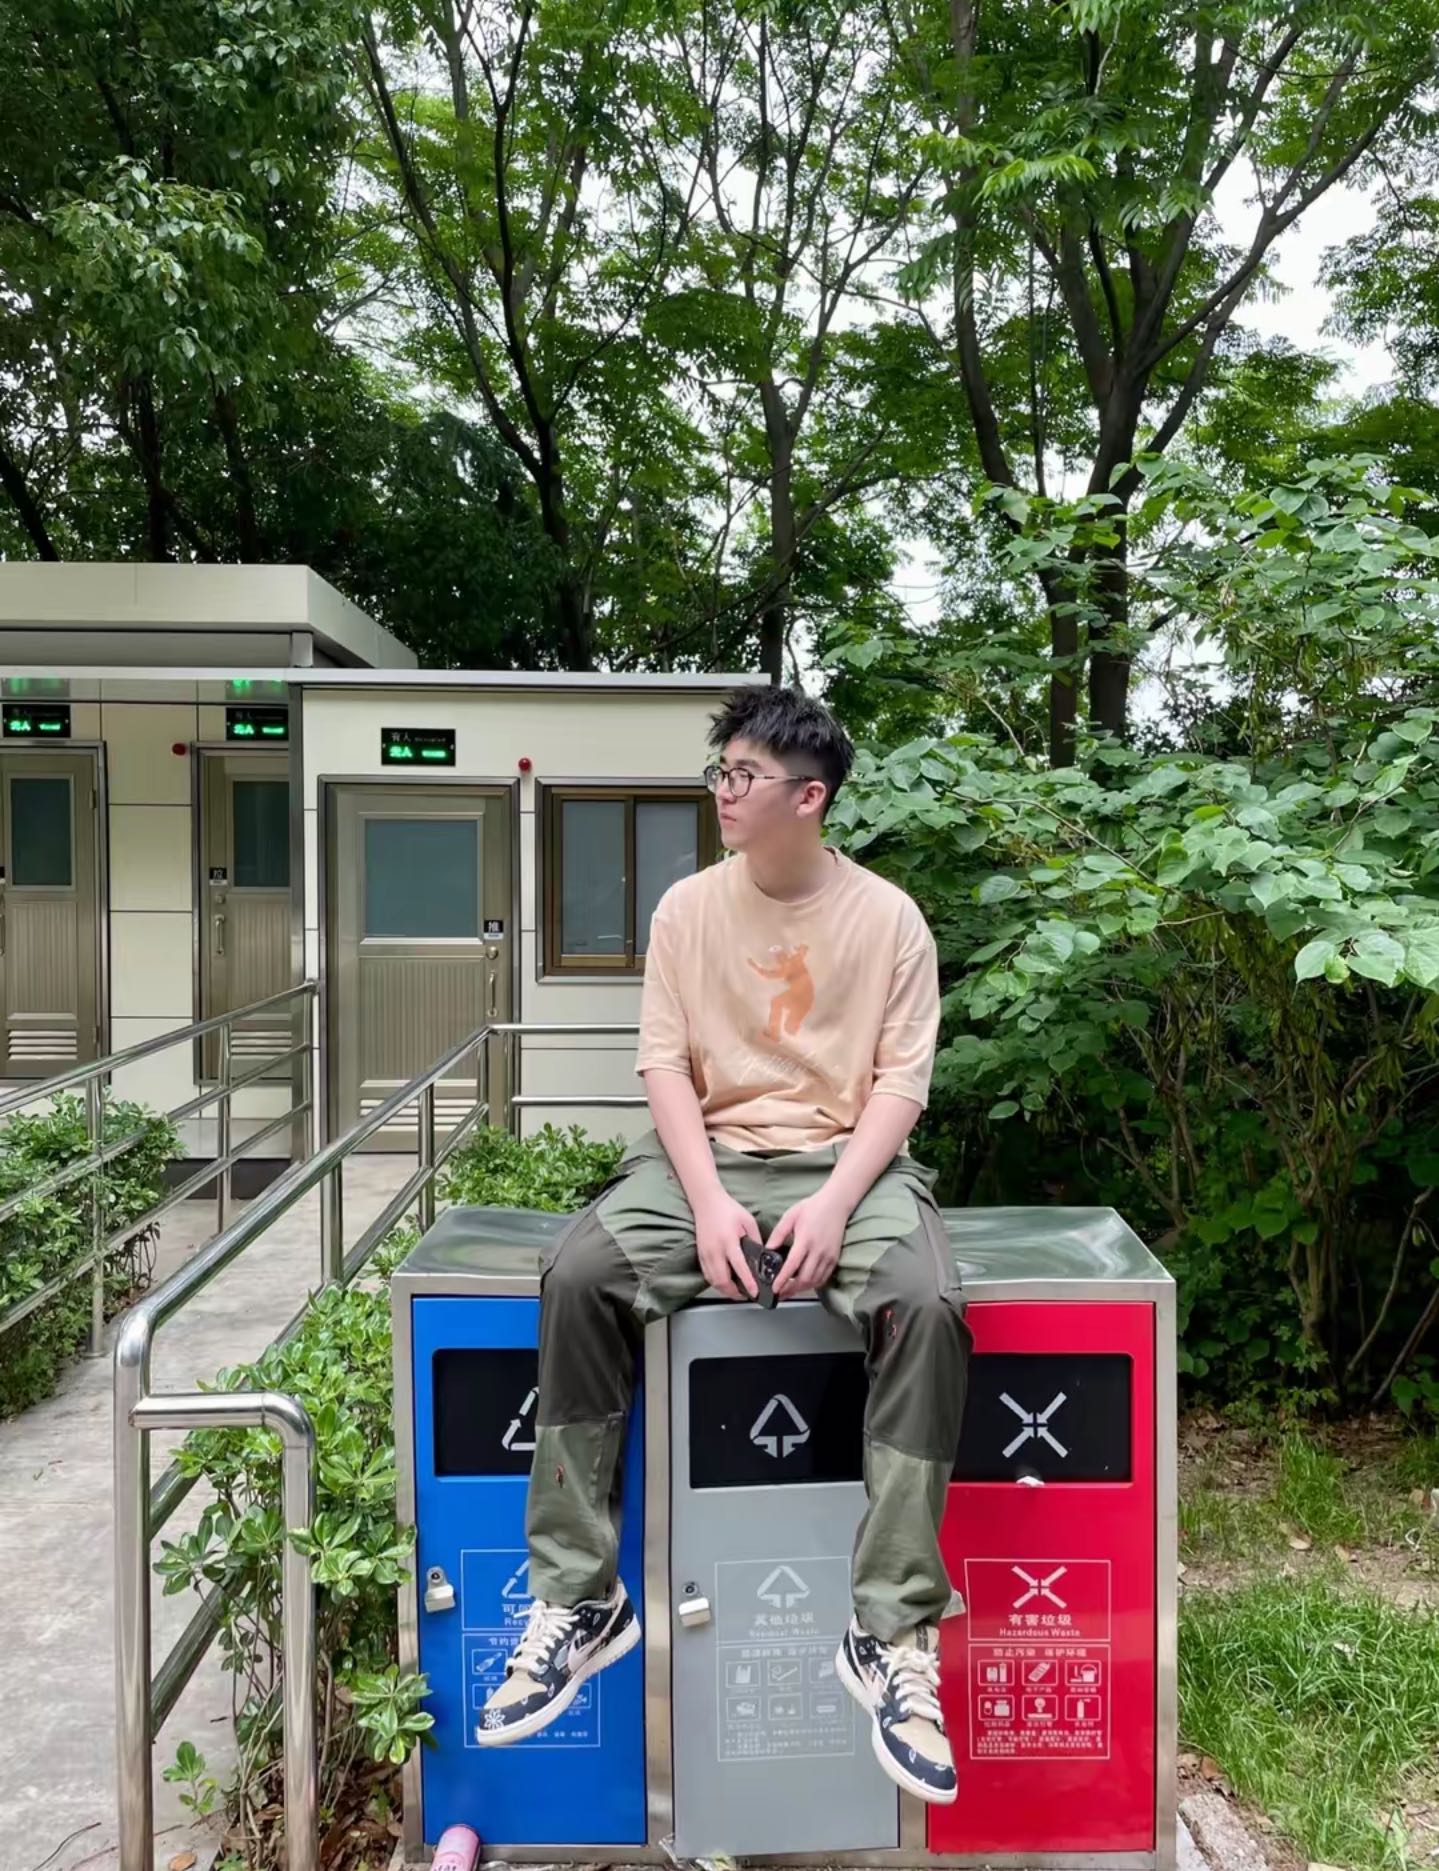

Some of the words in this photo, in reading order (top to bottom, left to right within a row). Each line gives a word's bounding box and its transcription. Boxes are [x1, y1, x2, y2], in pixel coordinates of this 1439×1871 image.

[1008, 1614, 1072, 1626] 有害垃圾
[1000, 1628, 1049, 1637] Hazardous
[1051, 1628, 1081, 1637] Waste
